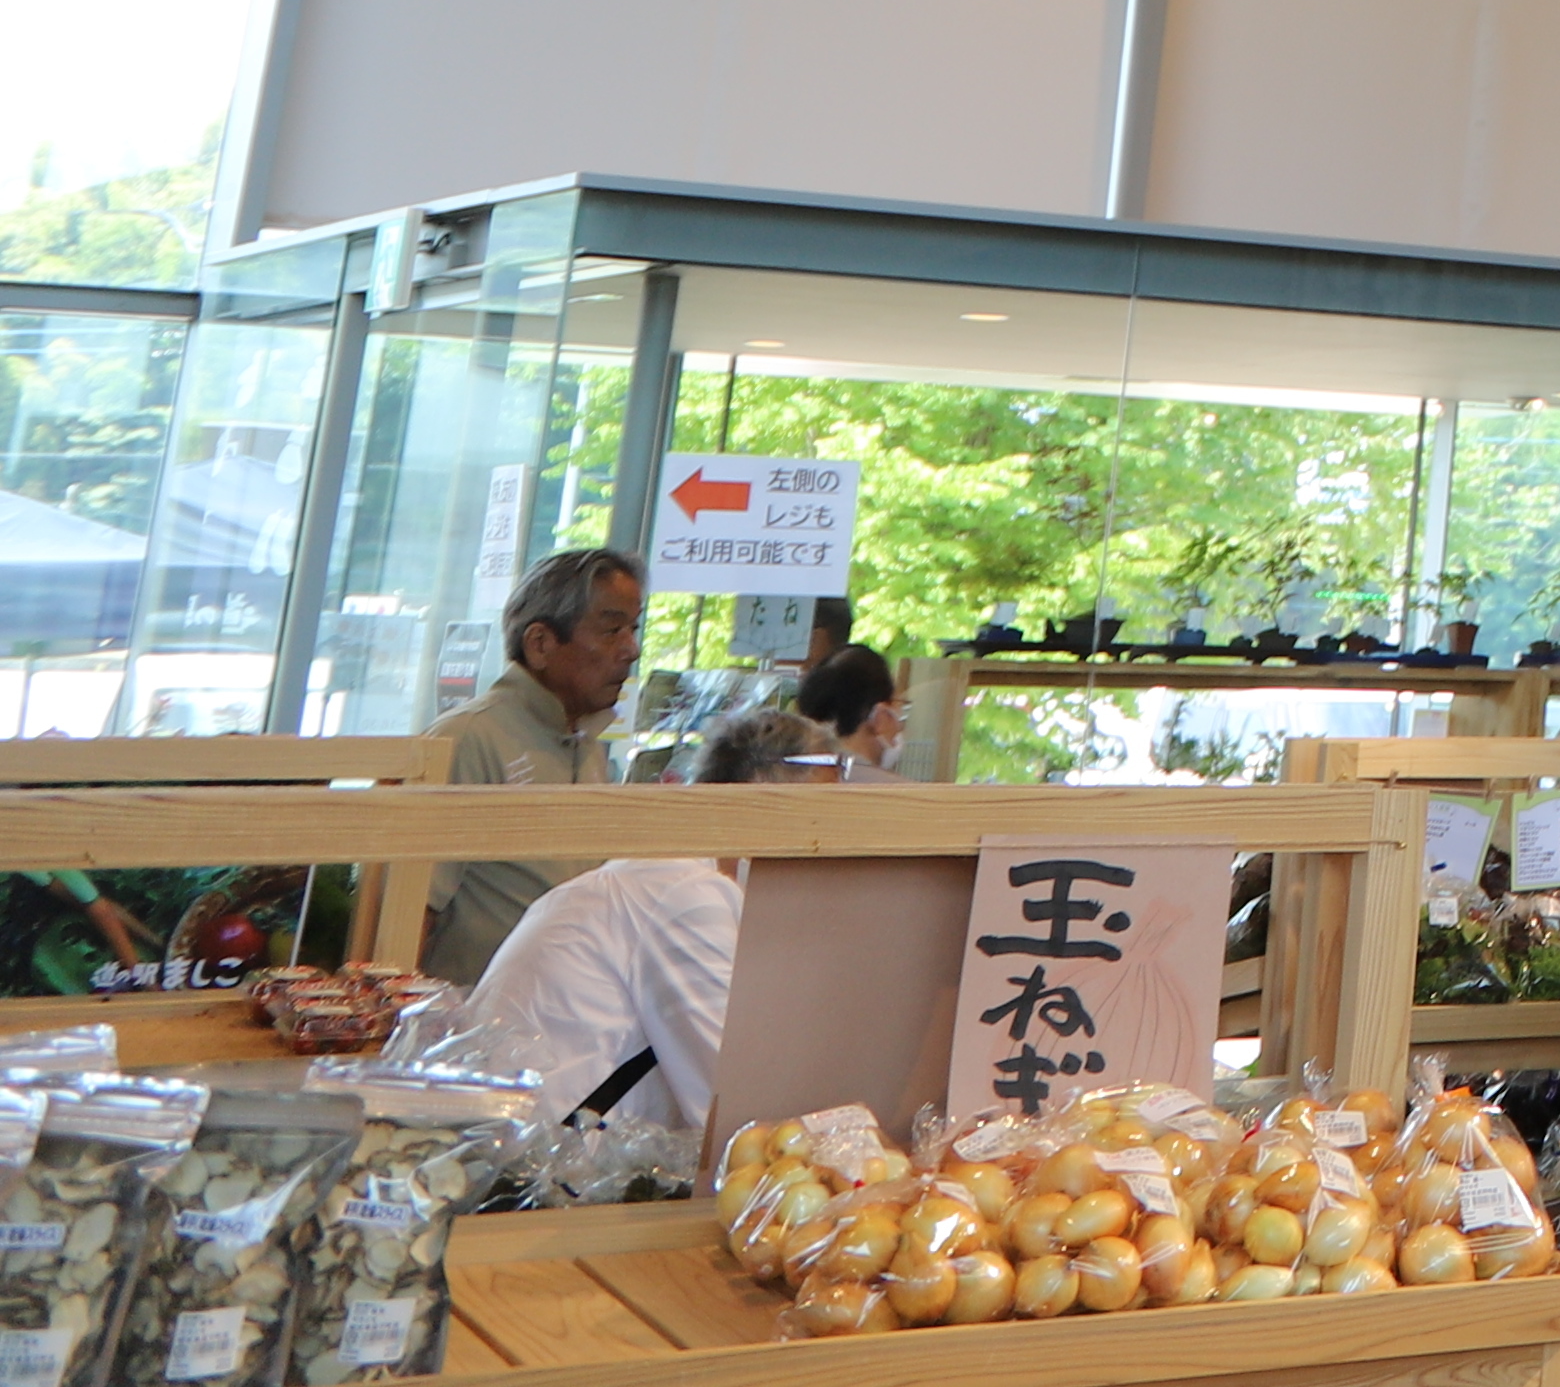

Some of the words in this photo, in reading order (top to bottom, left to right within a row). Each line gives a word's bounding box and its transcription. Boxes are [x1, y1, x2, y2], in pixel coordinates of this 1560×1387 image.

[766, 467, 840, 494] 左側の
[763, 503, 835, 529] レジも
[659, 537, 834, 565] ご利用可能です
[749, 596, 798, 627] たね
[975, 859, 1134, 1115] 玉ねぎ
